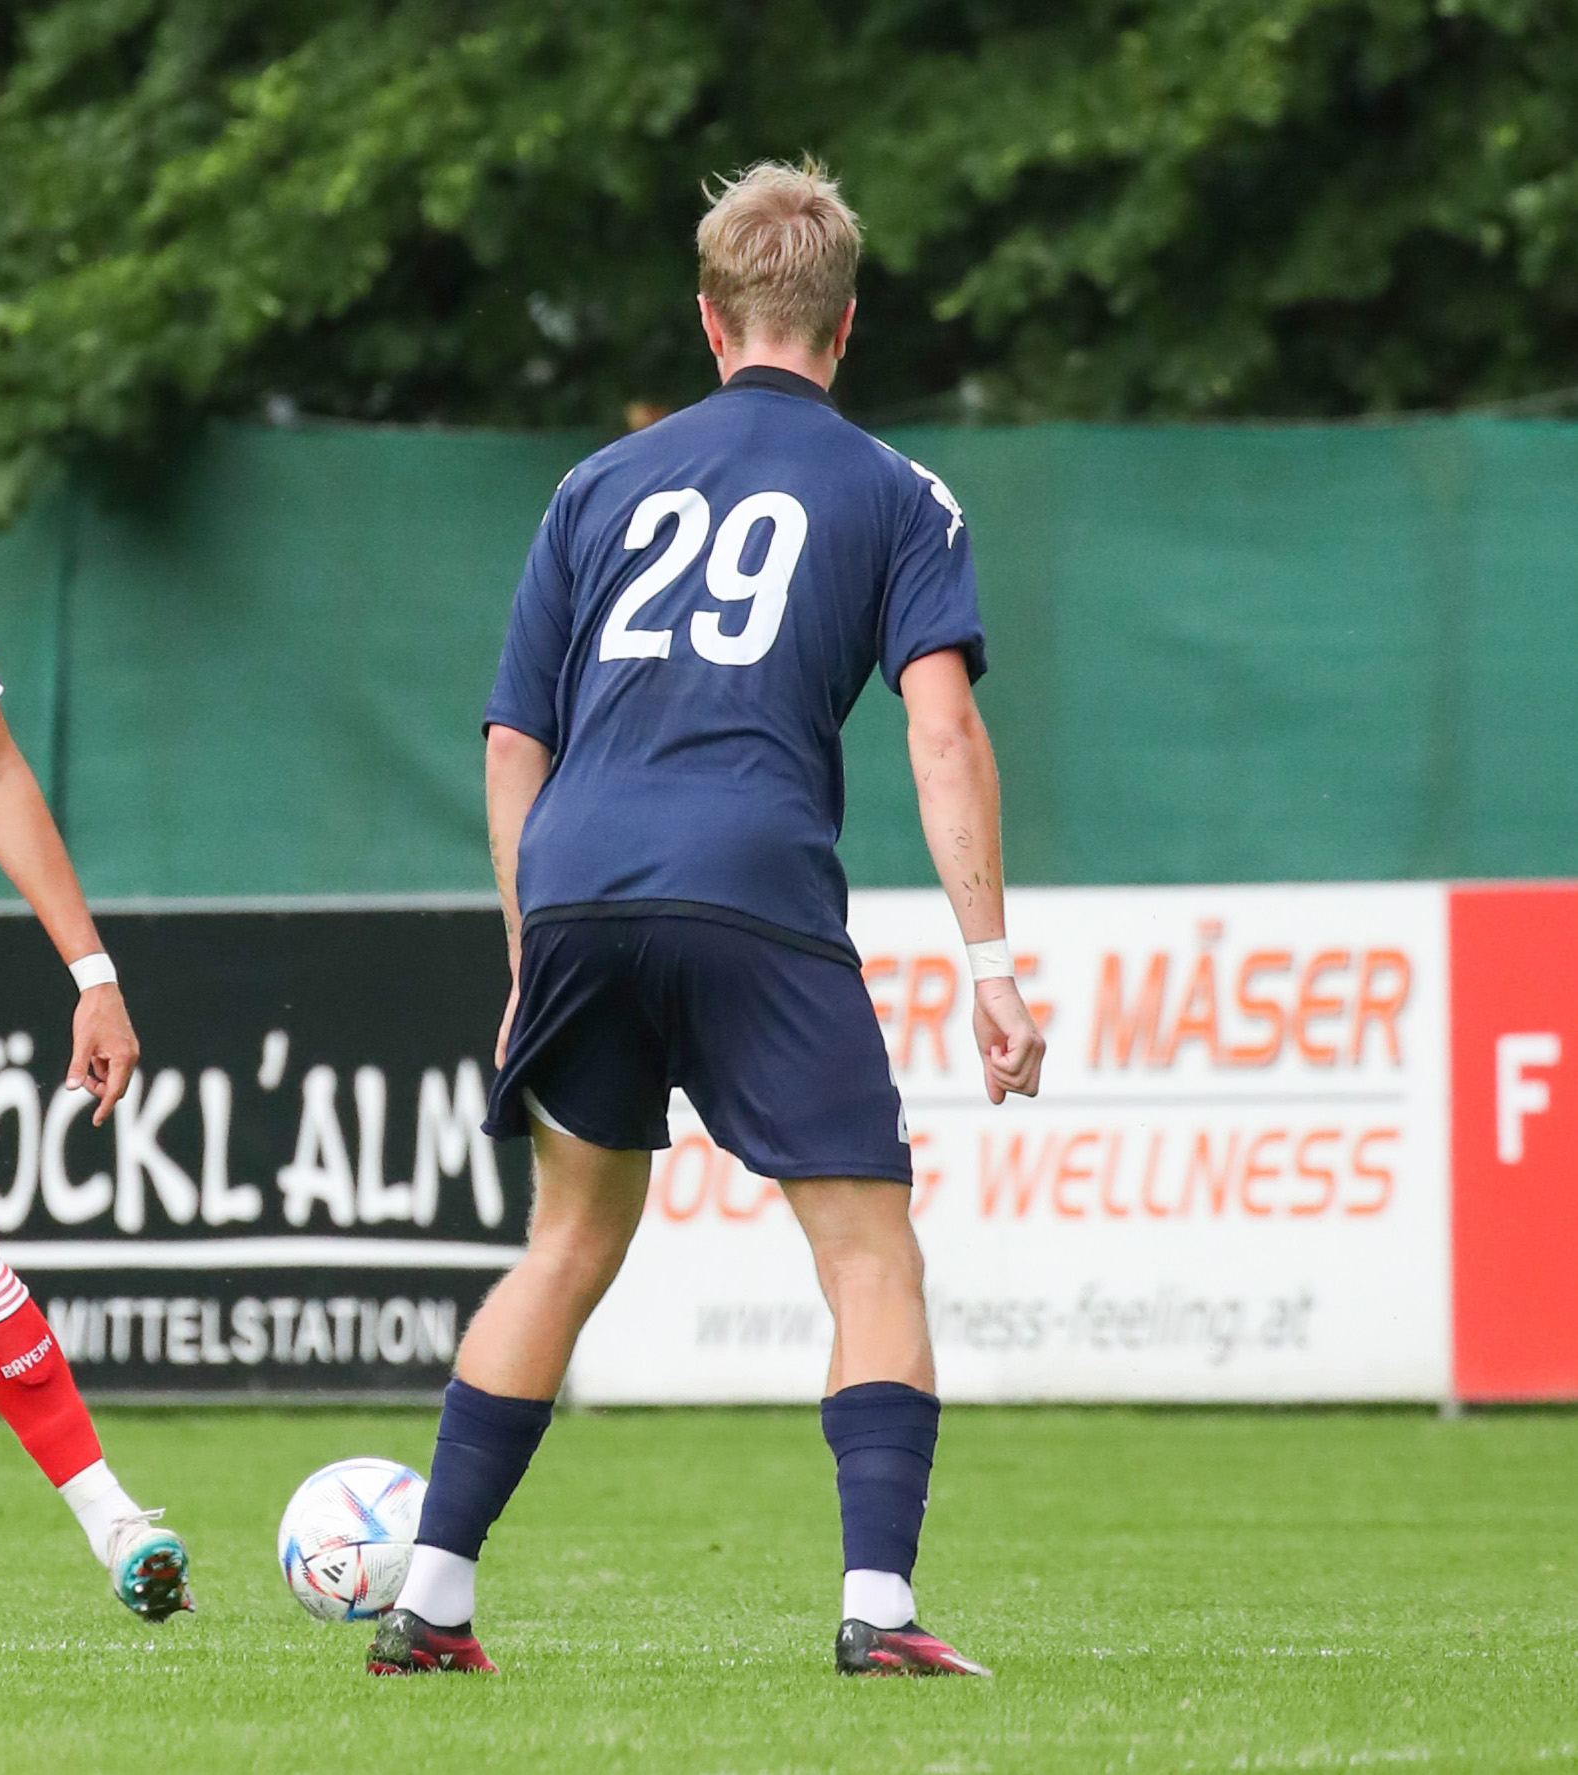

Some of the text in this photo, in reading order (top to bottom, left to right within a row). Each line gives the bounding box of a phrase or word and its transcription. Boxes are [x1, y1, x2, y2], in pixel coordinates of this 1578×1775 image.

[598, 487, 809, 666] 29
[1088, 920, 1414, 1070] MÄSER
[1495, 1031, 1563, 1165] F
[979, 1127, 1402, 1221] WELLNESS
[0, 1333, 53, 1379] BAYERN
[47, 1297, 458, 1366] MITTELSTATION
